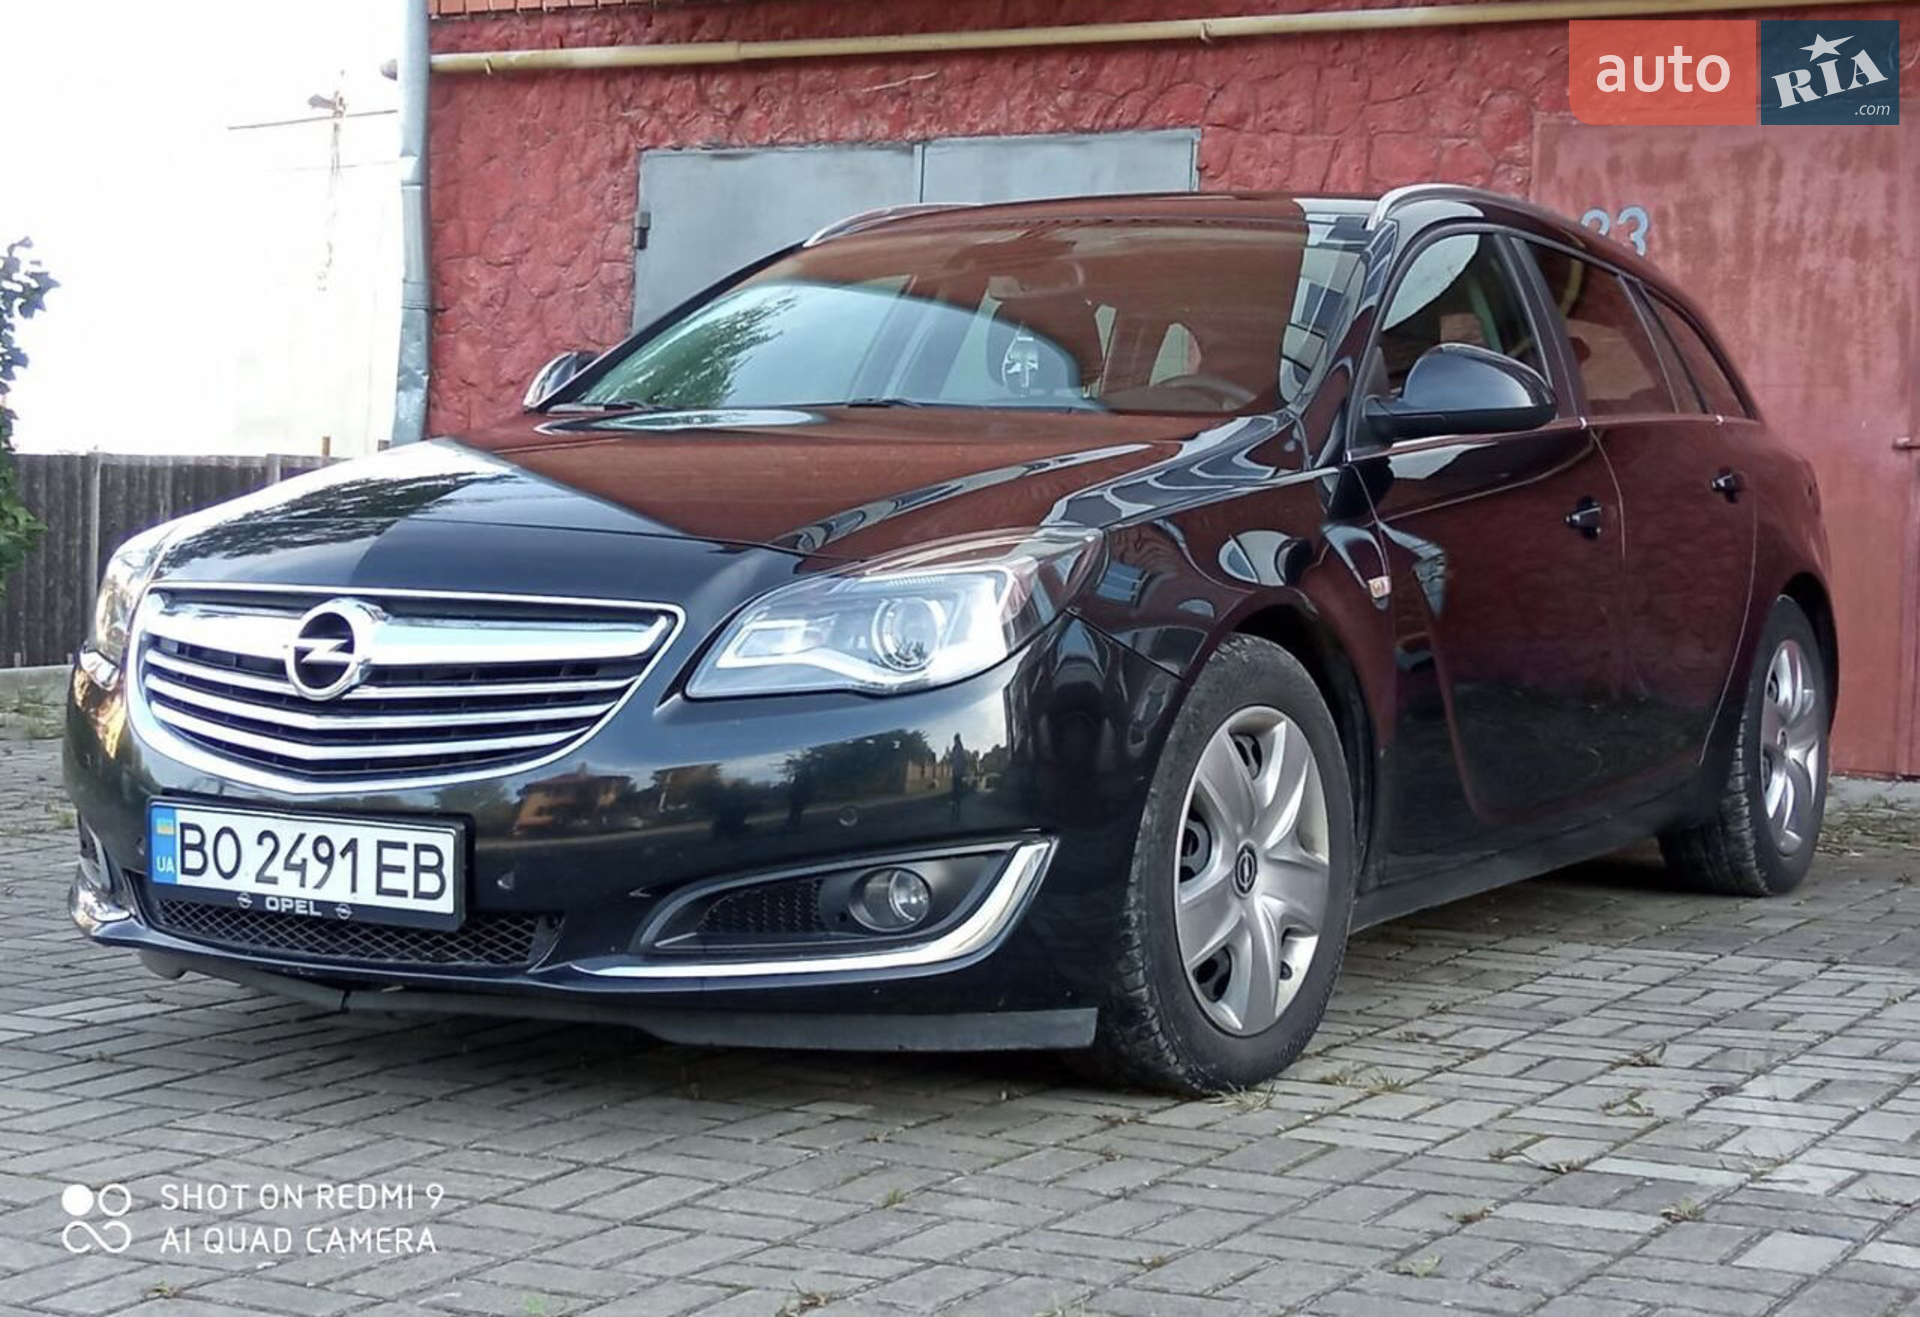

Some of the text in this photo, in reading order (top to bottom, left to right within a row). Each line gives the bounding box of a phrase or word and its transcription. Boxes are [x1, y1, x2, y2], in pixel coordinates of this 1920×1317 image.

[156, 855, 175, 874] UA
[180, 822, 447, 901] BO 2491 EB
[265, 896, 322, 917] OPEL
